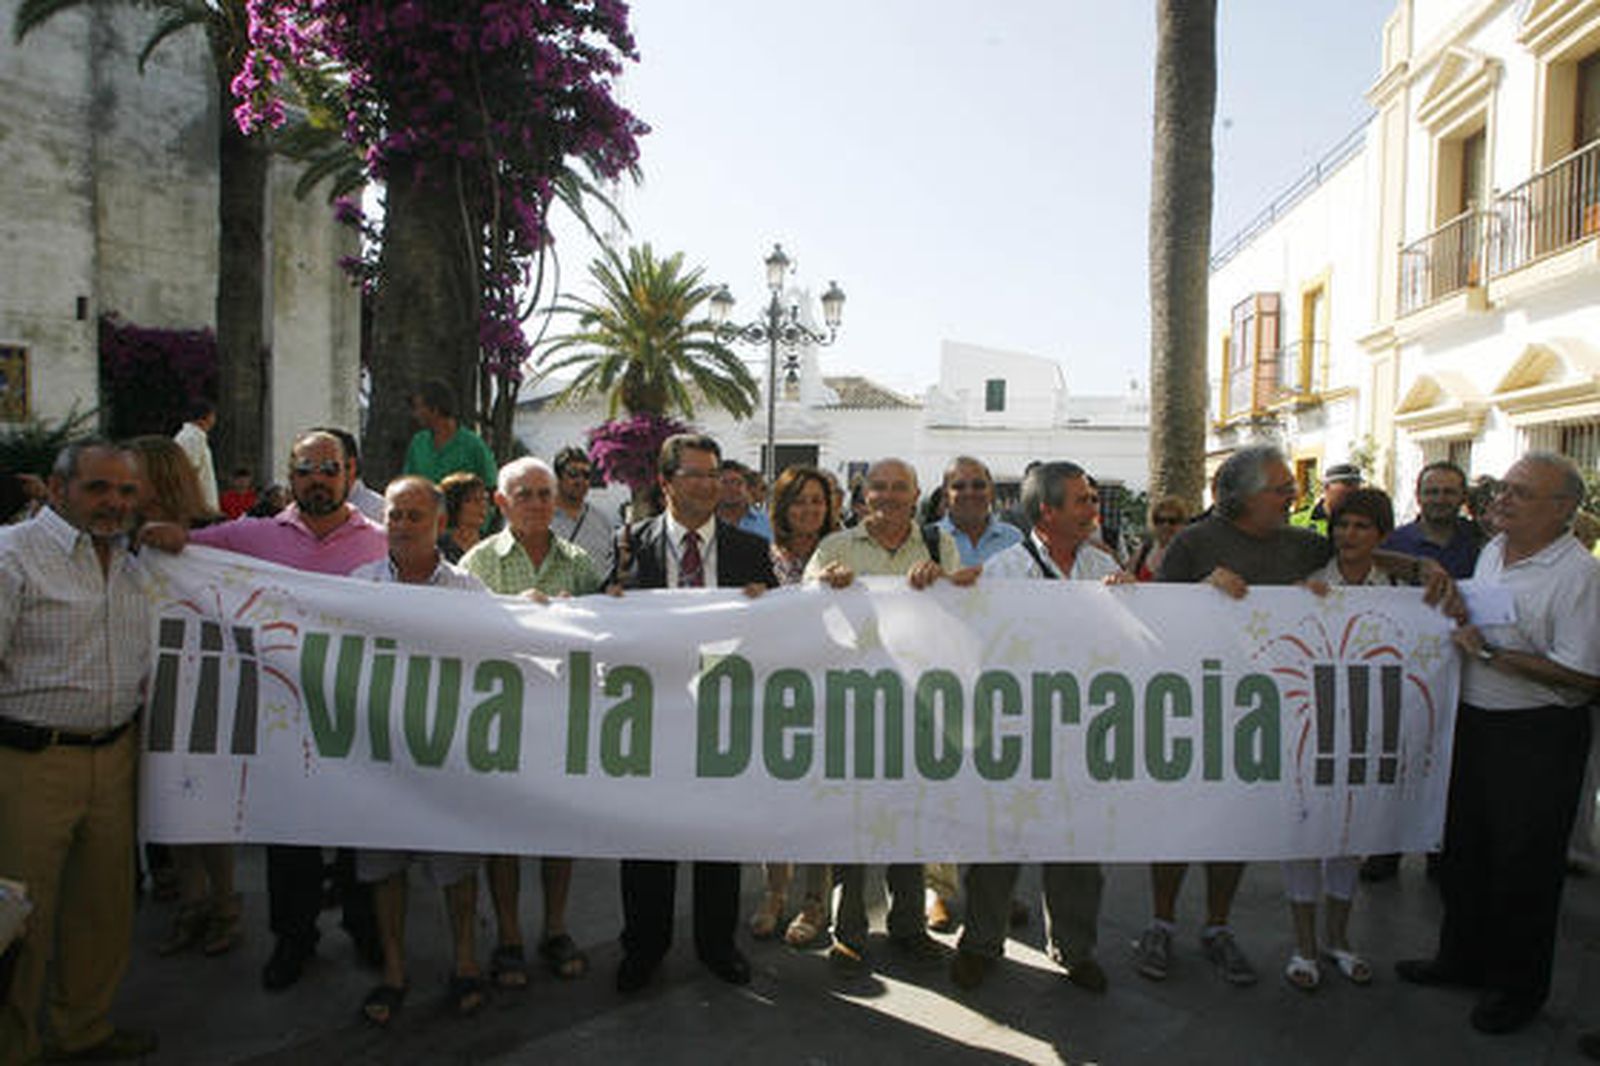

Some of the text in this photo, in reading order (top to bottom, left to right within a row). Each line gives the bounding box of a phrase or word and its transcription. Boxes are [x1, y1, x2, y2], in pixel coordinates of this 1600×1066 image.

[302, 632, 524, 773] Viva
[566, 651, 653, 778] la
[696, 654, 1281, 784] Democracia
